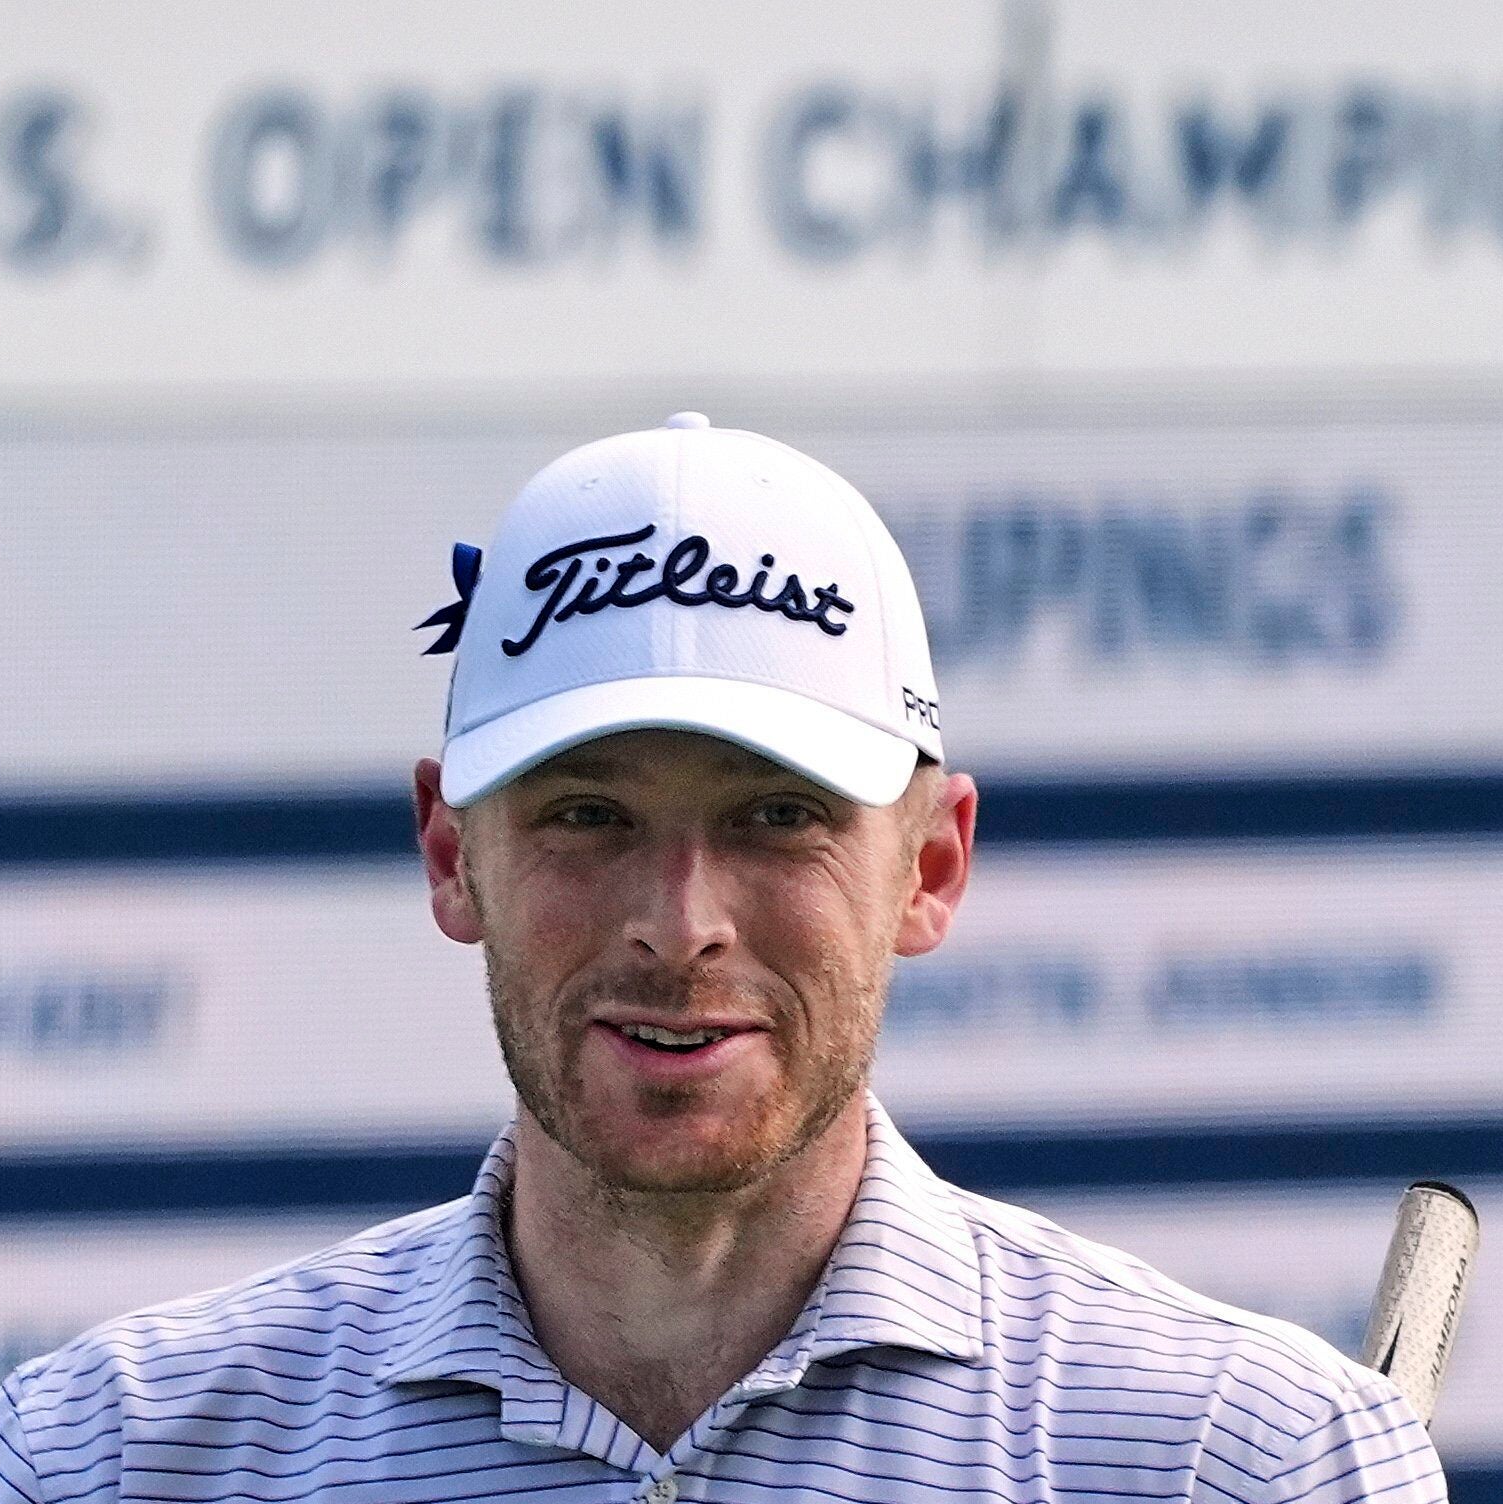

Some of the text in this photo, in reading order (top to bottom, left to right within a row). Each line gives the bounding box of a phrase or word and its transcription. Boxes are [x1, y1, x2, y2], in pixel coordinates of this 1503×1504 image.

[216, 84, 704, 268] OPEN
[501, 522, 855, 657] Titleist
[904, 490, 1401, 672] UPINGS
[1430, 1250, 1468, 1385] JUMBOMA
